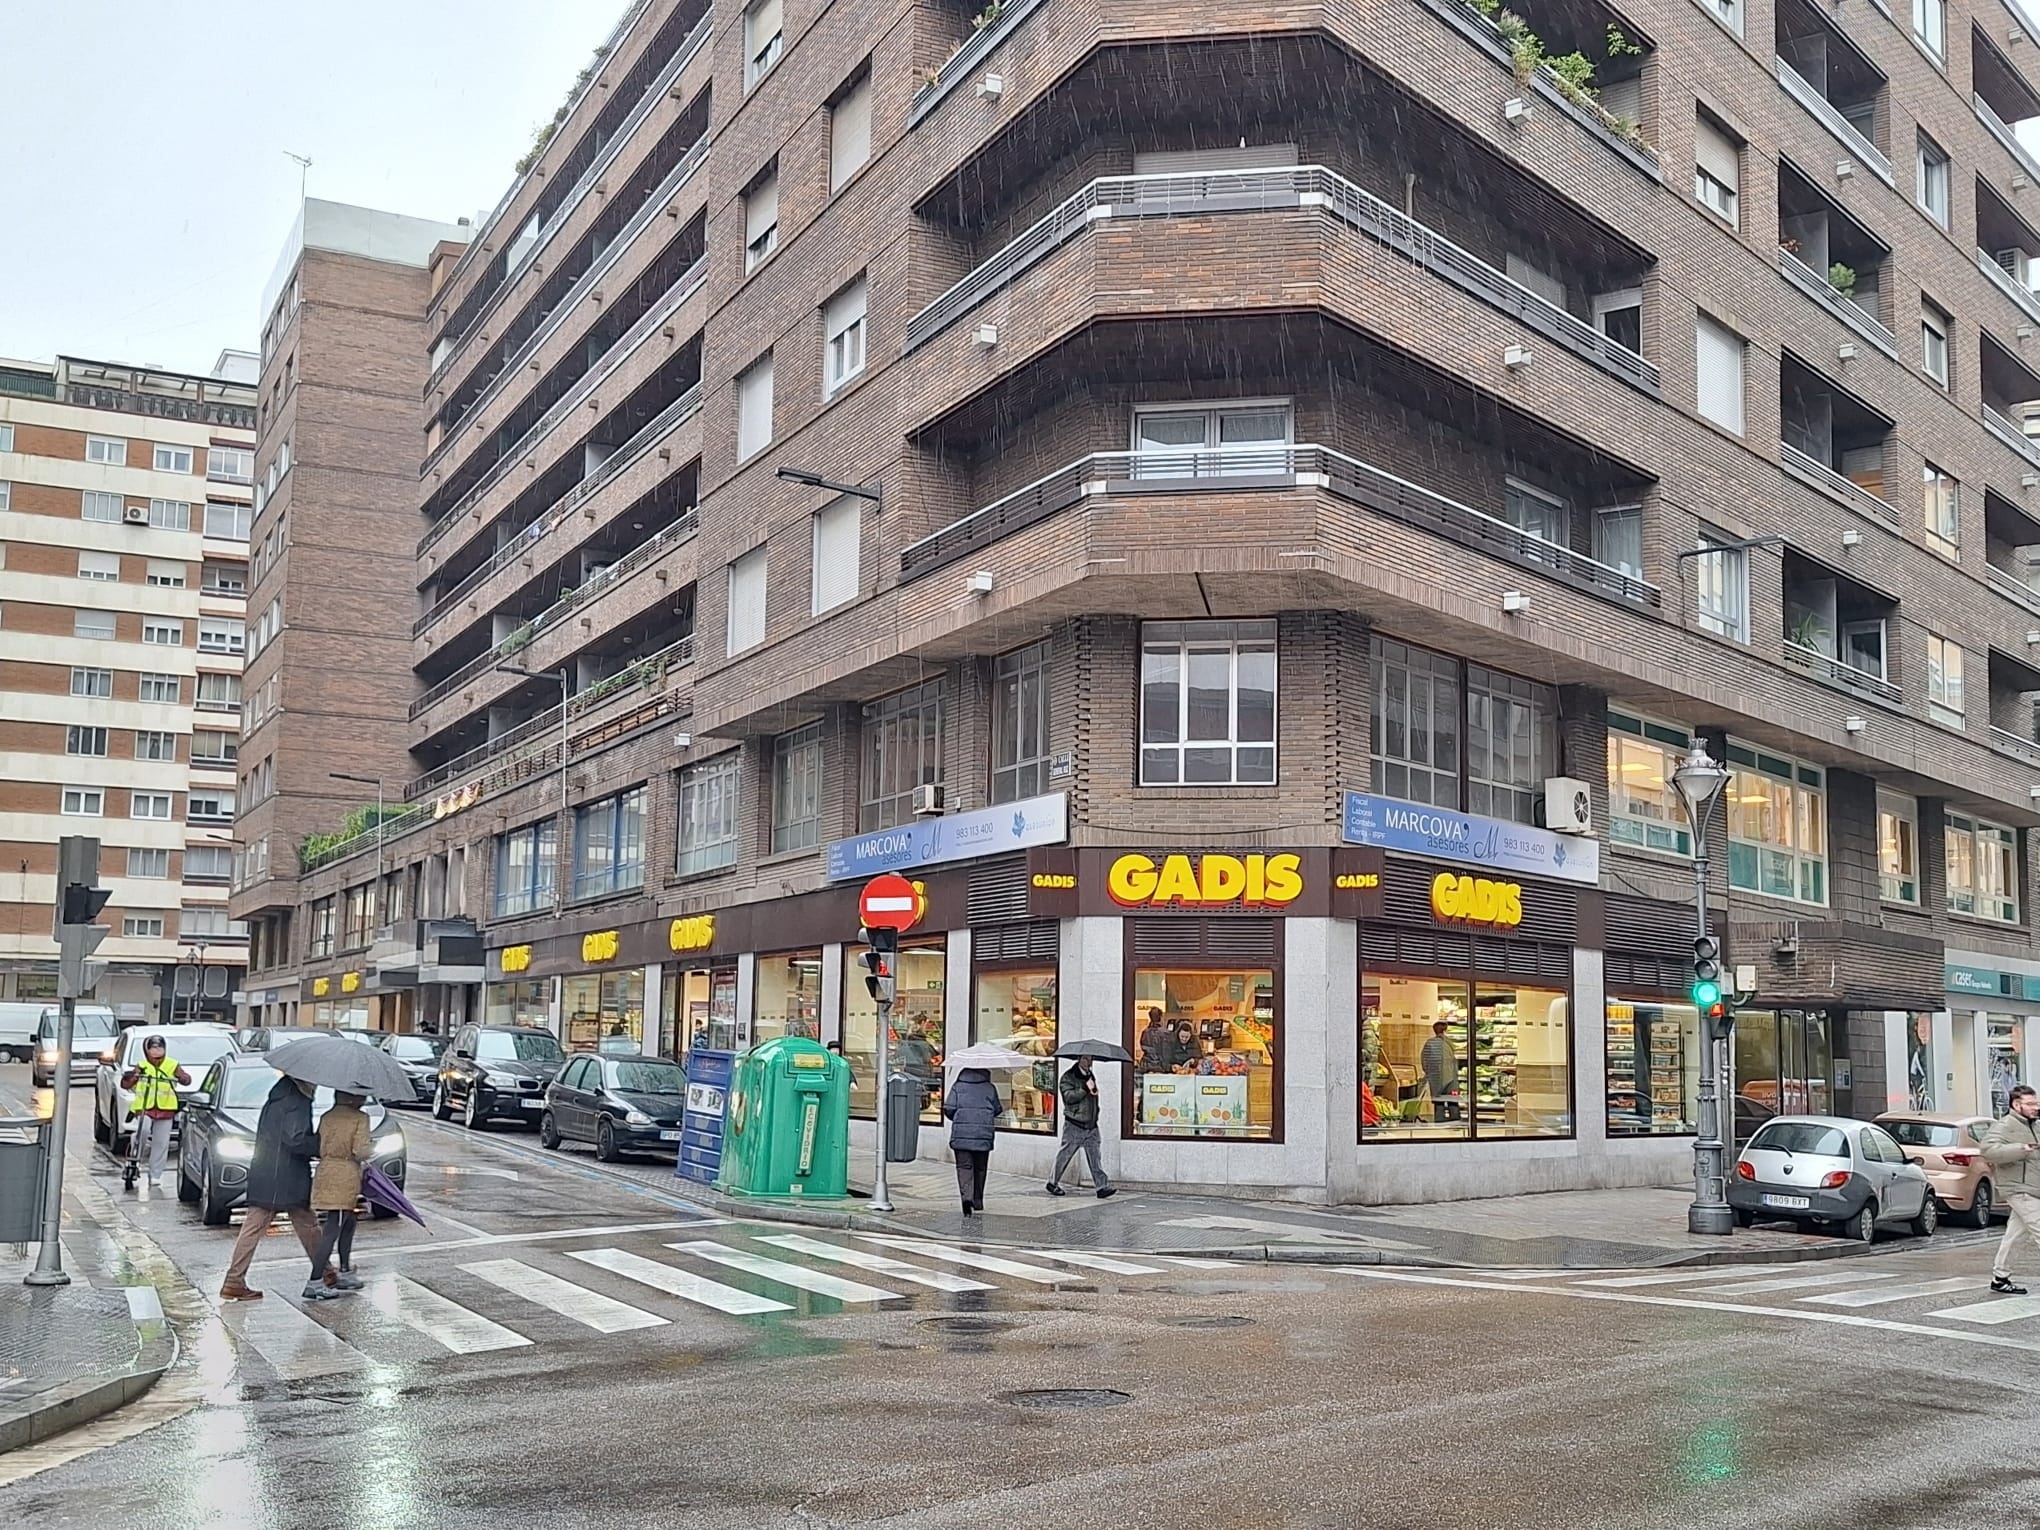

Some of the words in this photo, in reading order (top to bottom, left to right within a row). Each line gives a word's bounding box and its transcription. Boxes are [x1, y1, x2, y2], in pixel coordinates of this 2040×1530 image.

[955, 828, 969, 839] 983
[970, 825, 980, 837] 113
[980, 822, 994, 834] 400
[1385, 807, 1463, 841] MARCOVA
[856, 834, 908, 860] MARCOVA
[1427, 836, 1470, 854] asesores
[1503, 838, 1518, 850] 983
[1520, 840, 1530, 853] 113
[1531, 844, 1545, 855] 400
[1032, 873, 1076, 888] GADIS
[1109, 853, 1303, 904] GADIS
[1336, 873, 1379, 888] GADIS
[1432, 872, 1523, 927] GADIS
[669, 915, 715, 951] GADIS
